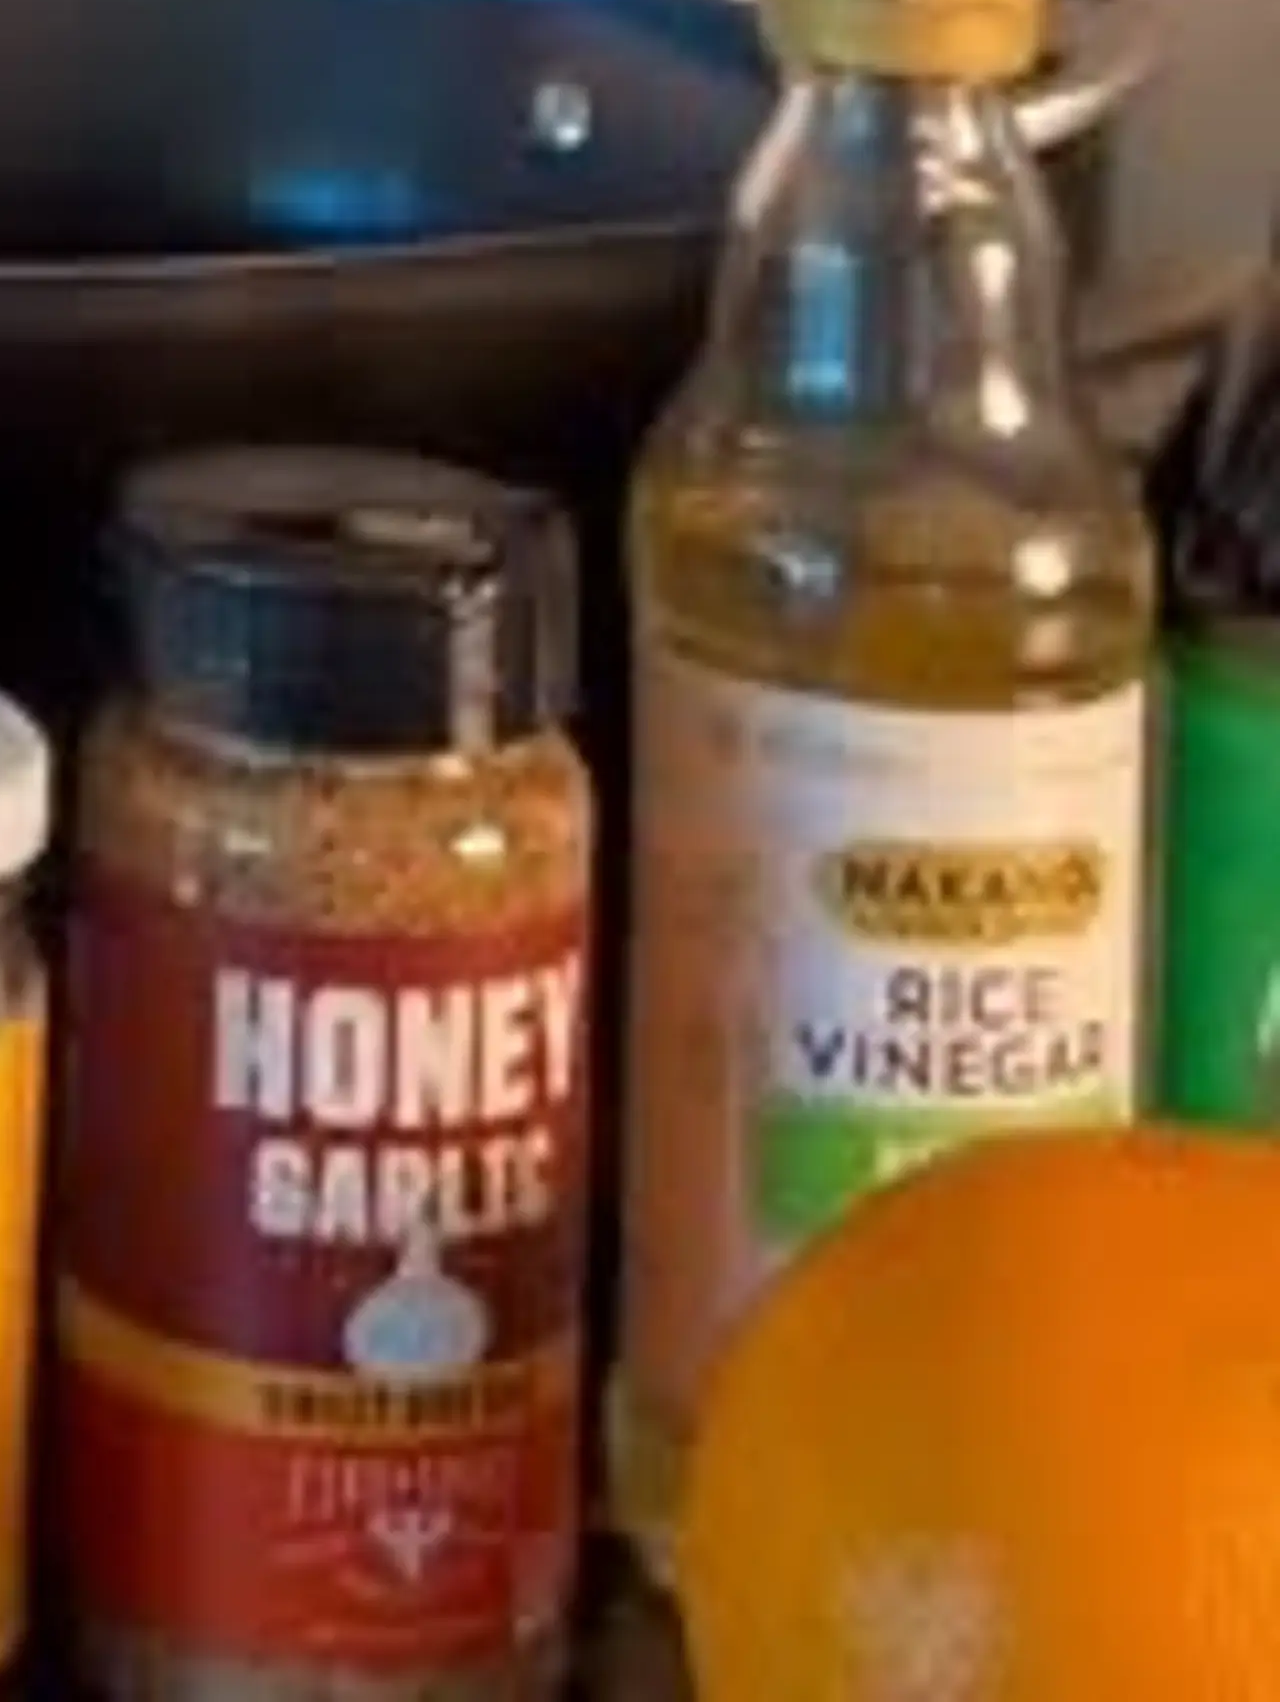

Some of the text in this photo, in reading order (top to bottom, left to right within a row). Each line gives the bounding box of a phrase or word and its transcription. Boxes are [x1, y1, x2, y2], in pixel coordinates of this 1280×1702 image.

[215, 954, 580, 1129] HONEY
[794, 1020, 1104, 1096] VINEGAR
[886, 964, 1060, 1050] RICE
[252, 1126, 552, 1244] GARLIC
